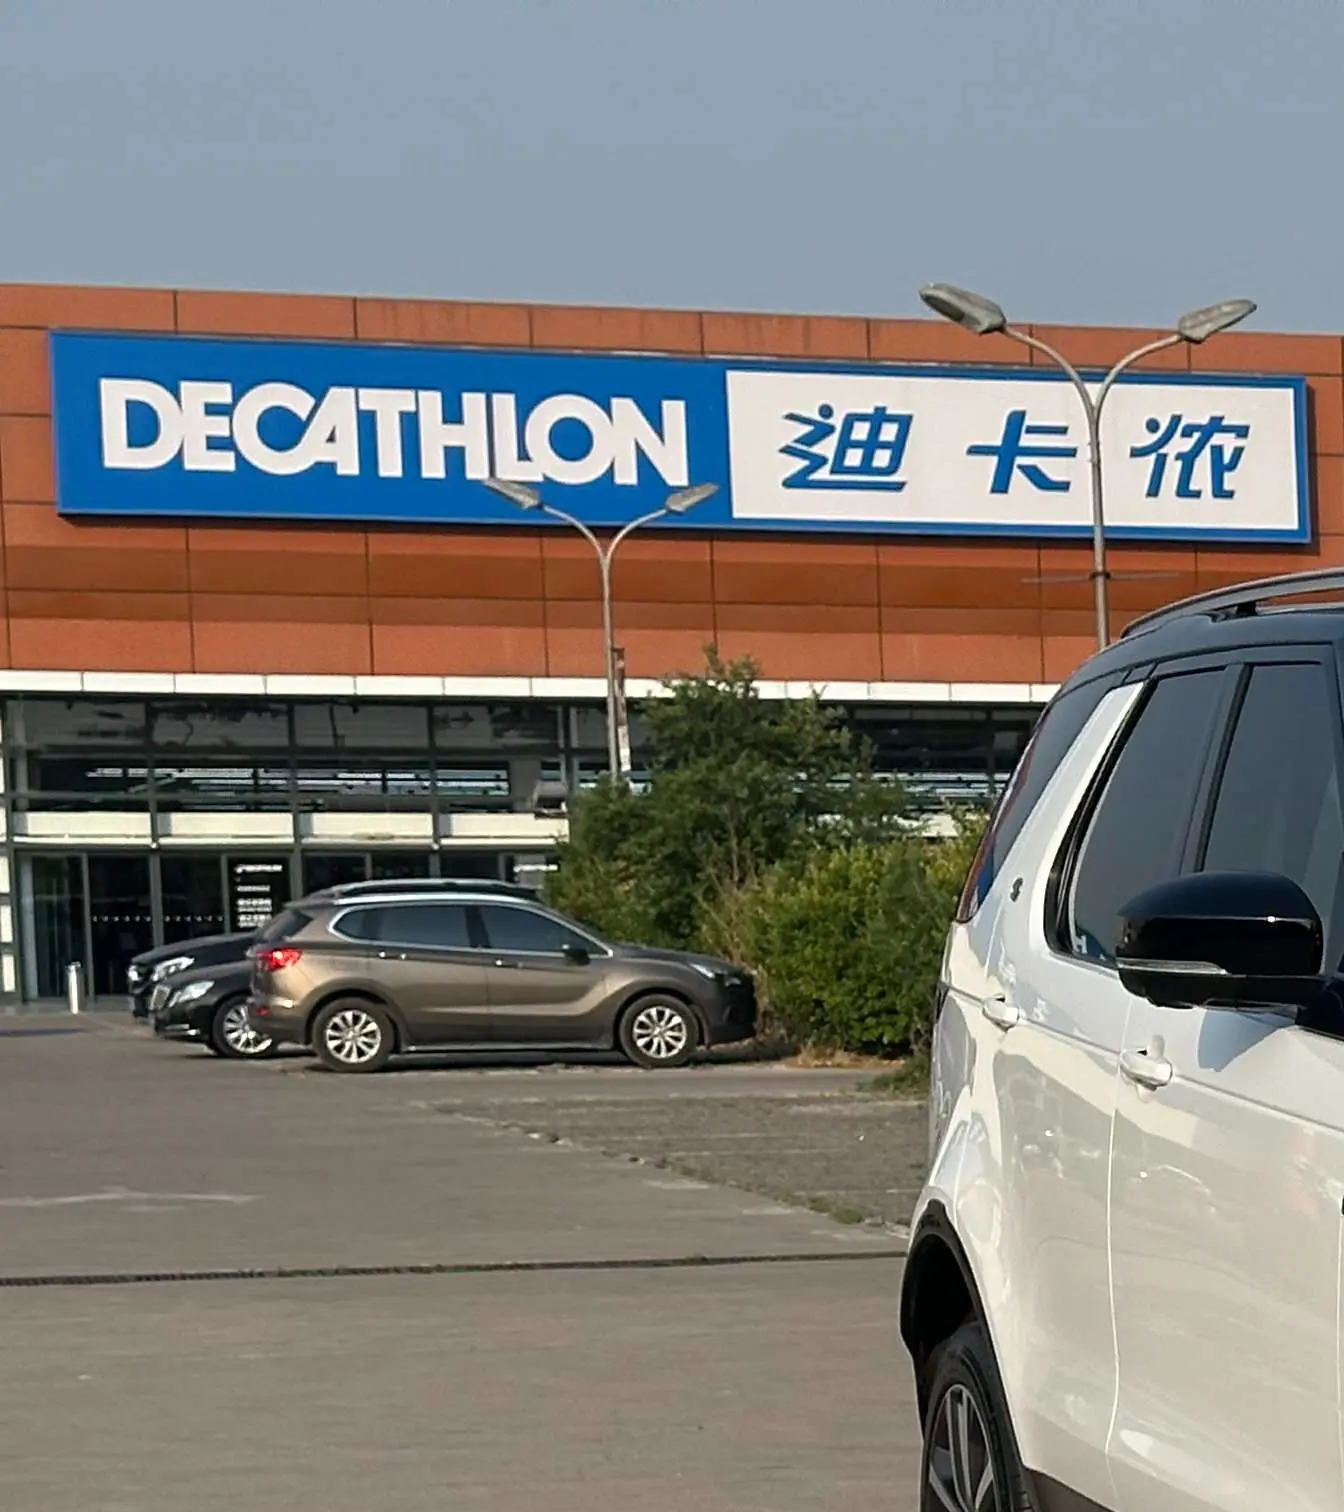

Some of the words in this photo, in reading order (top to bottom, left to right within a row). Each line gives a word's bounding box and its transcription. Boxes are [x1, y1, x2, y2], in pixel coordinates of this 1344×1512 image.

[100, 378, 690, 486] DECATHLON
[778, 403, 1251, 499] 迪卡侬
